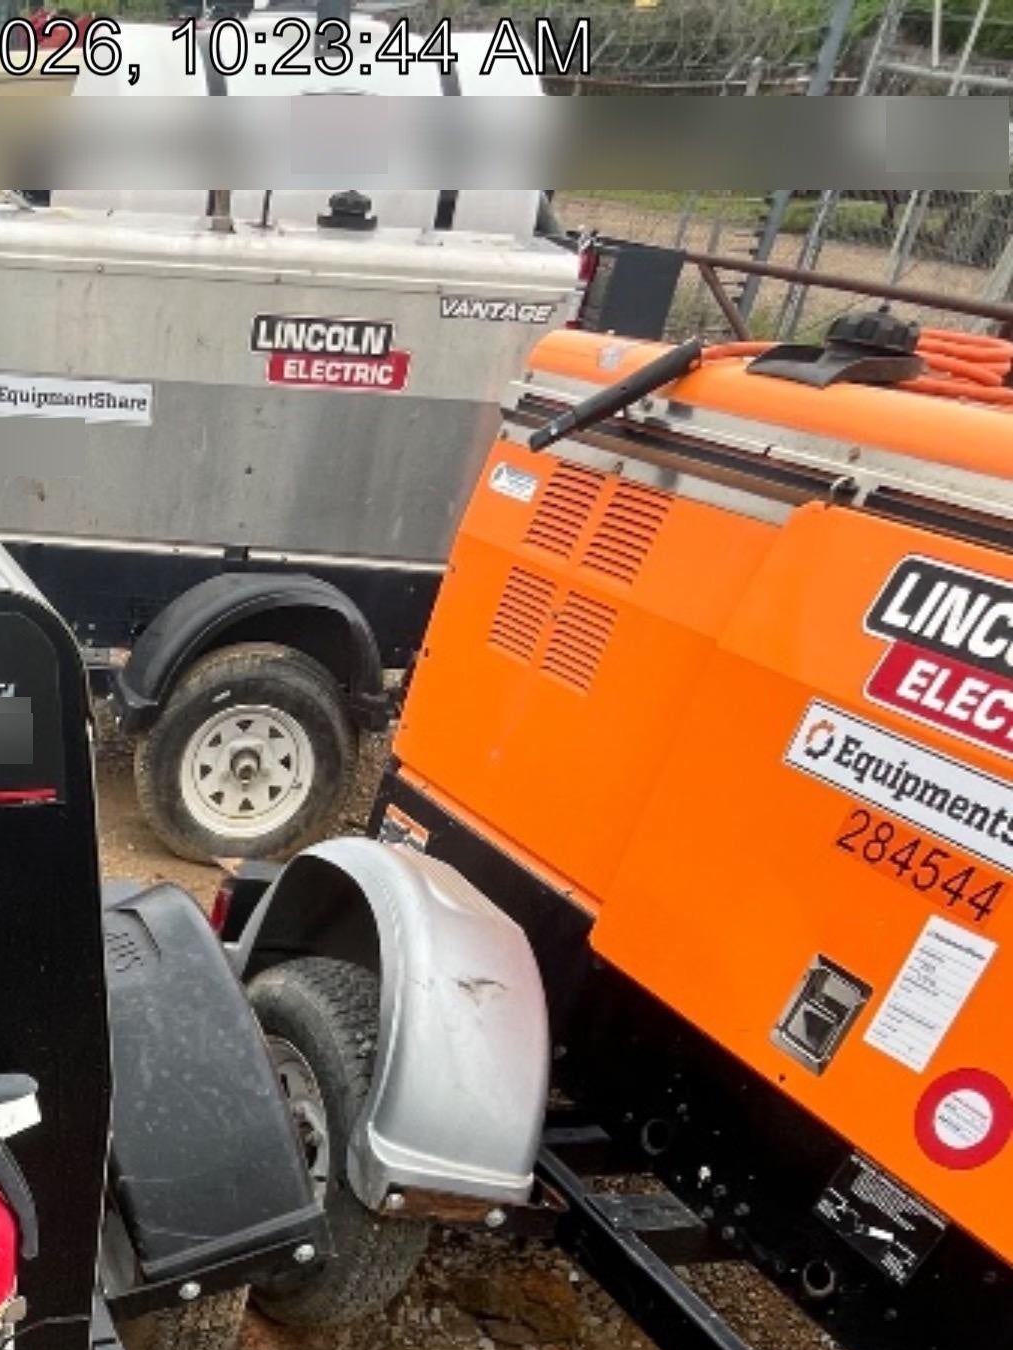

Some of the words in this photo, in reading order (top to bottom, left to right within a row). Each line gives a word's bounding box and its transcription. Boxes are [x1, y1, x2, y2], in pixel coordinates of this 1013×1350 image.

[257, 320, 387, 355] LINCOLN
[440, 299, 553, 323] VANTAGE
[283, 359, 393, 385] ELECTRIC
[881, 572, 1013, 667] LINC
[896, 659, 1013, 739] ELEC
[836, 809, 1005, 922] 284544
